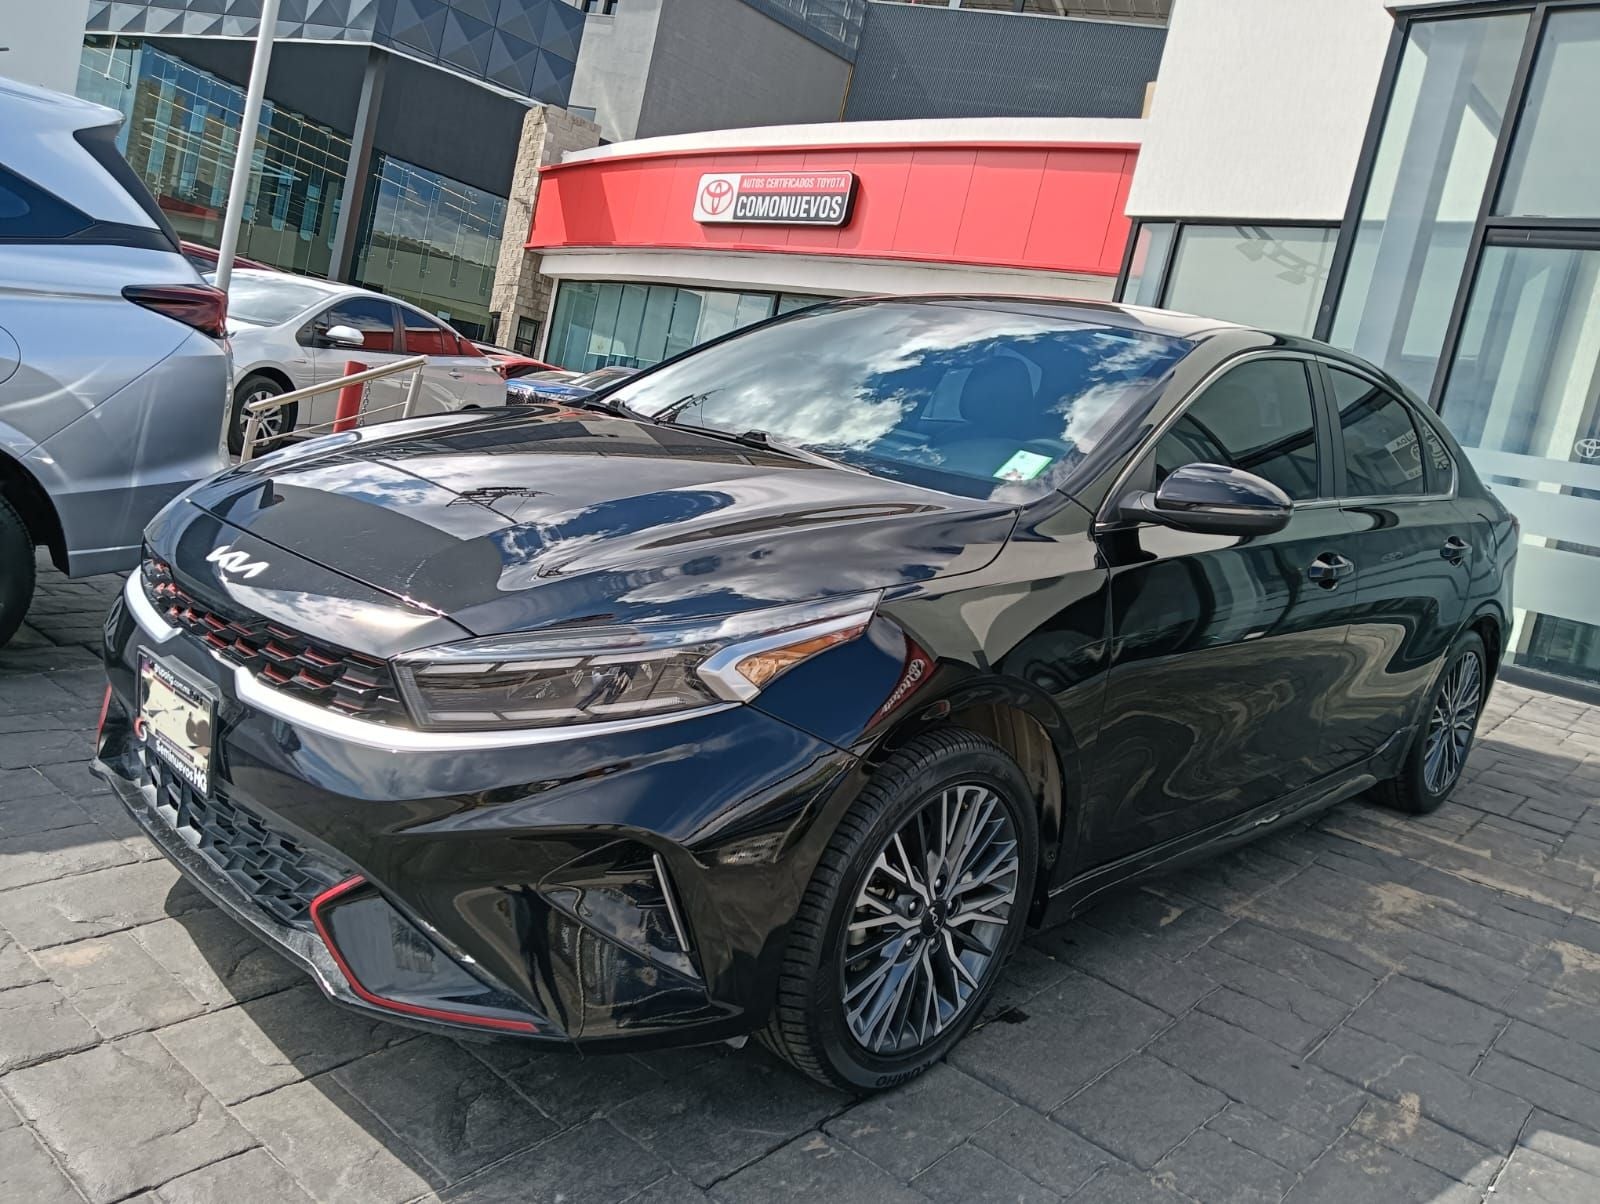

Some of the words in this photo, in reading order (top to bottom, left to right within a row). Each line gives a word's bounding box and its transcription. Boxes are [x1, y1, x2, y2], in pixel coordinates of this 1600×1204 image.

[743, 178, 765, 188] AUTOS
[766, 178, 814, 188] CERTIFICADOS
[816, 177, 845, 188] TOYOTA
[736, 195, 841, 219] COMONUEVOS
